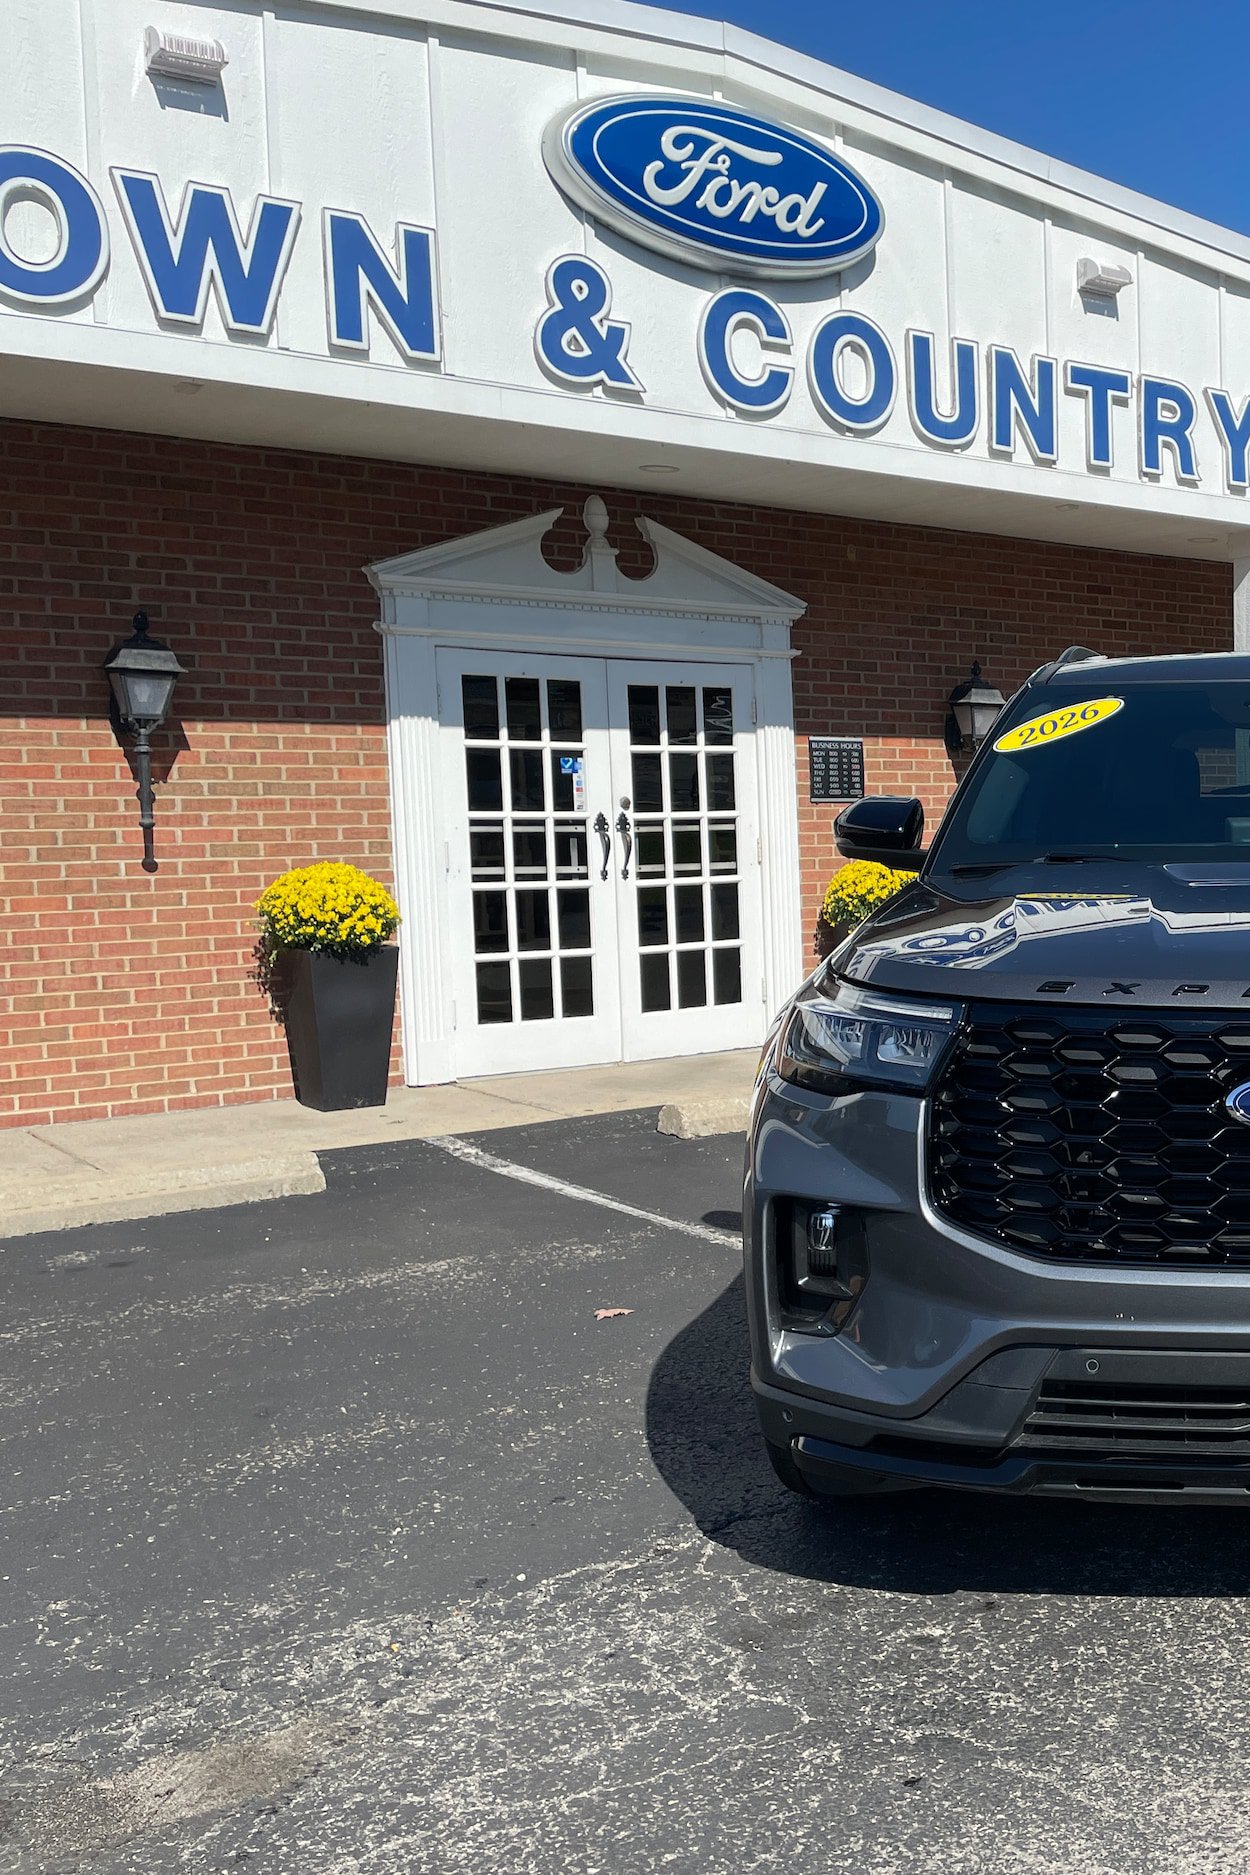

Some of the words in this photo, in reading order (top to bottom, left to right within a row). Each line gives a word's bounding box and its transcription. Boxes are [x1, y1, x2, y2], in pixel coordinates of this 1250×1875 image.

[643, 125, 828, 238] Ford
[0, 144, 442, 362] OWN
[536, 253, 645, 392] &
[840, 742, 862, 750] HOURS
[1018, 703, 1099, 746] 2026
